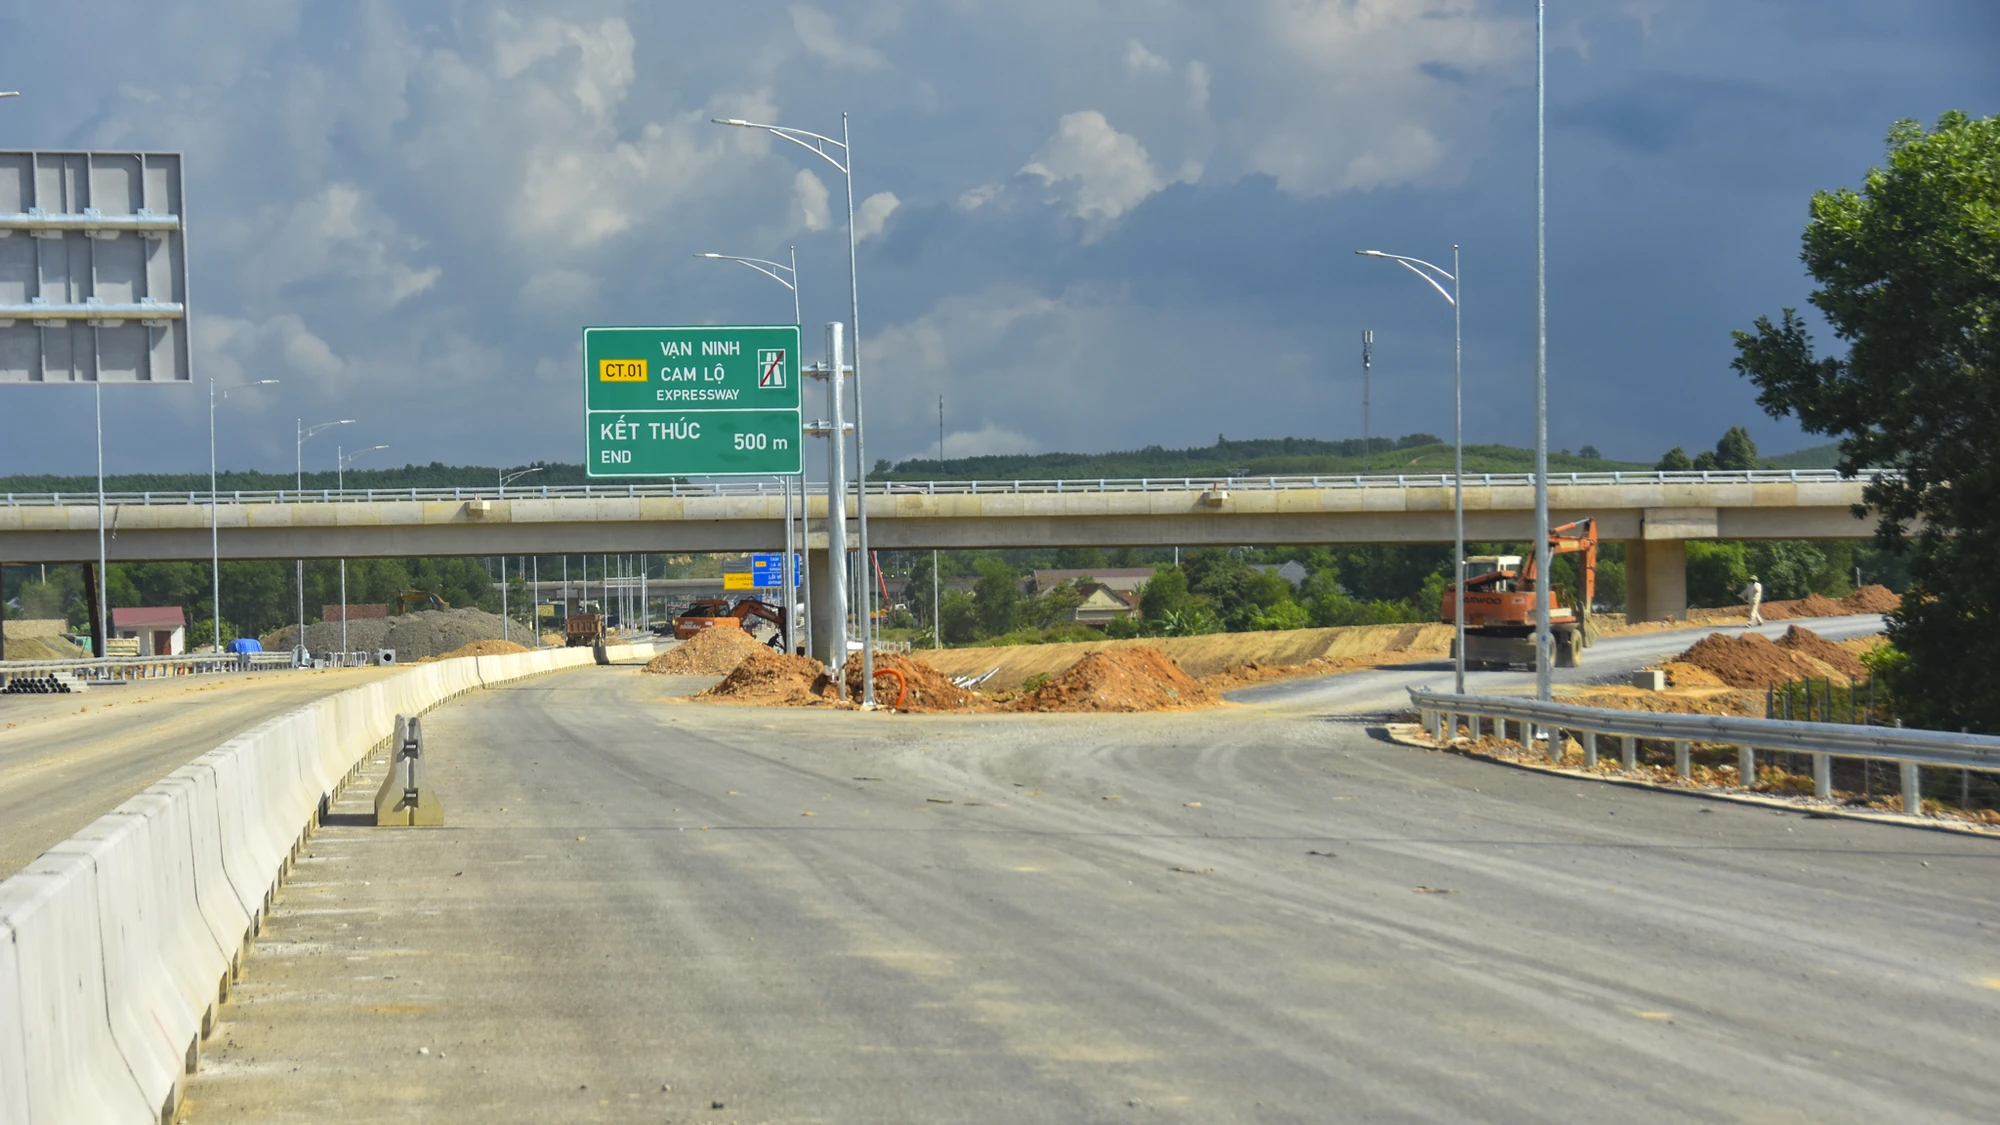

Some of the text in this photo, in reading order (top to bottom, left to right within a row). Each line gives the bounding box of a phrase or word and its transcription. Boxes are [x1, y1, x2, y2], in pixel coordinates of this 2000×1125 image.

[660, 341, 740, 359] VẠN NINH
[605, 364, 643, 378] CT.01
[661, 363, 725, 384] CAM LỘ
[656, 389, 740, 401] EXPRESSWAY
[601, 414, 701, 441] KẾT THÚC
[734, 433, 788, 450] 500 m
[601, 450, 632, 464] END
[1463, 596, 1502, 605] AEWOO
